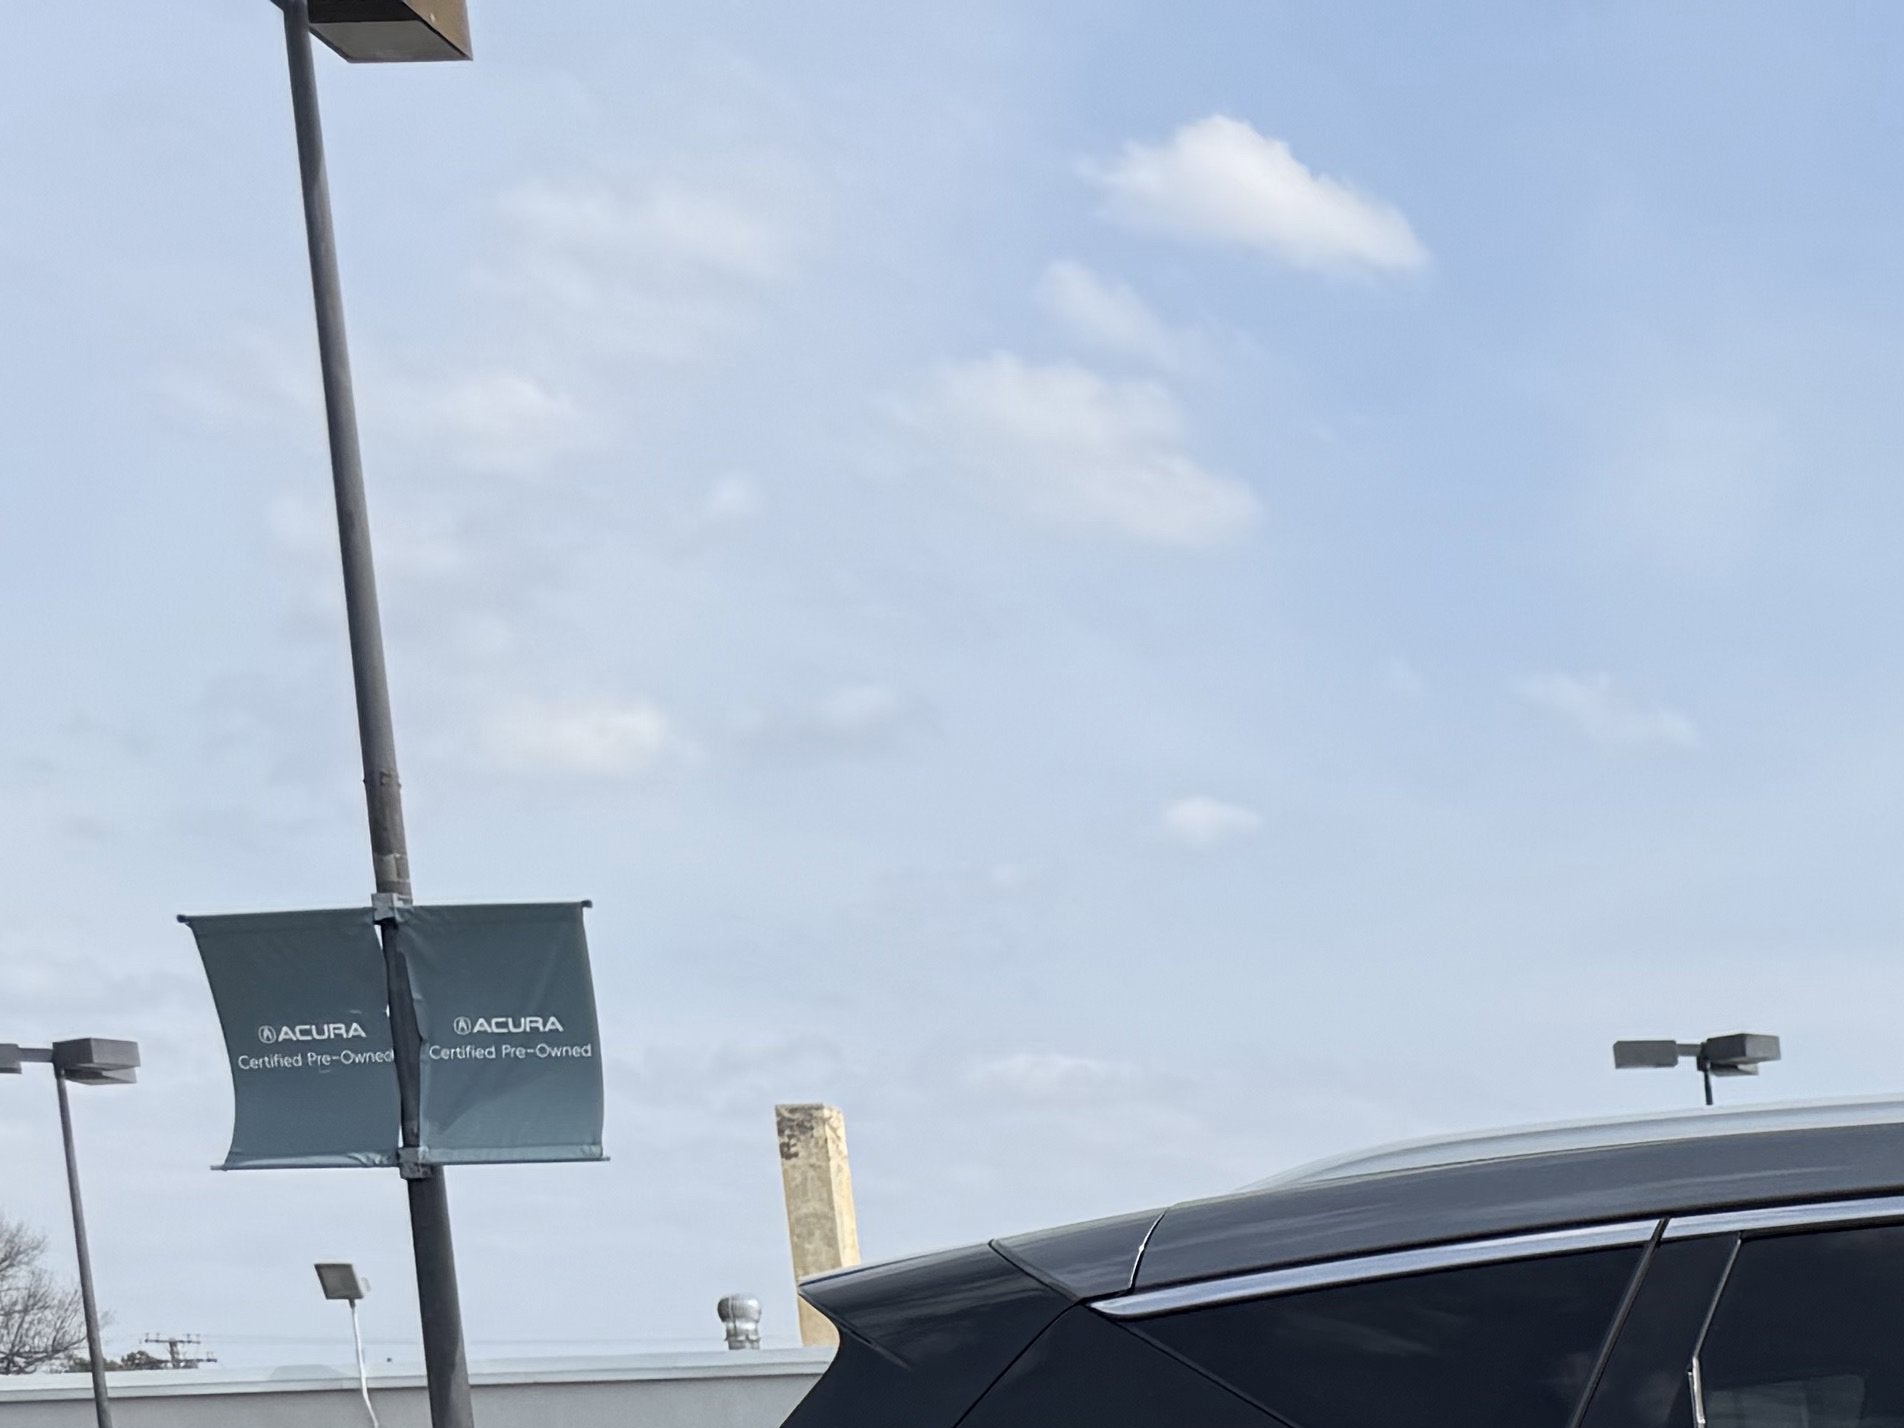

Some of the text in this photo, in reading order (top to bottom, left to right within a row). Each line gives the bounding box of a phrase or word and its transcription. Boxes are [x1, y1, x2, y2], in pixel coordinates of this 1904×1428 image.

[277, 1022, 367, 1042] ACURA
[472, 1016, 564, 1034] ACURA
[238, 1049, 395, 1070] Certified Pre-Owned
[429, 1042, 592, 1060] Certified Pre-Owned
